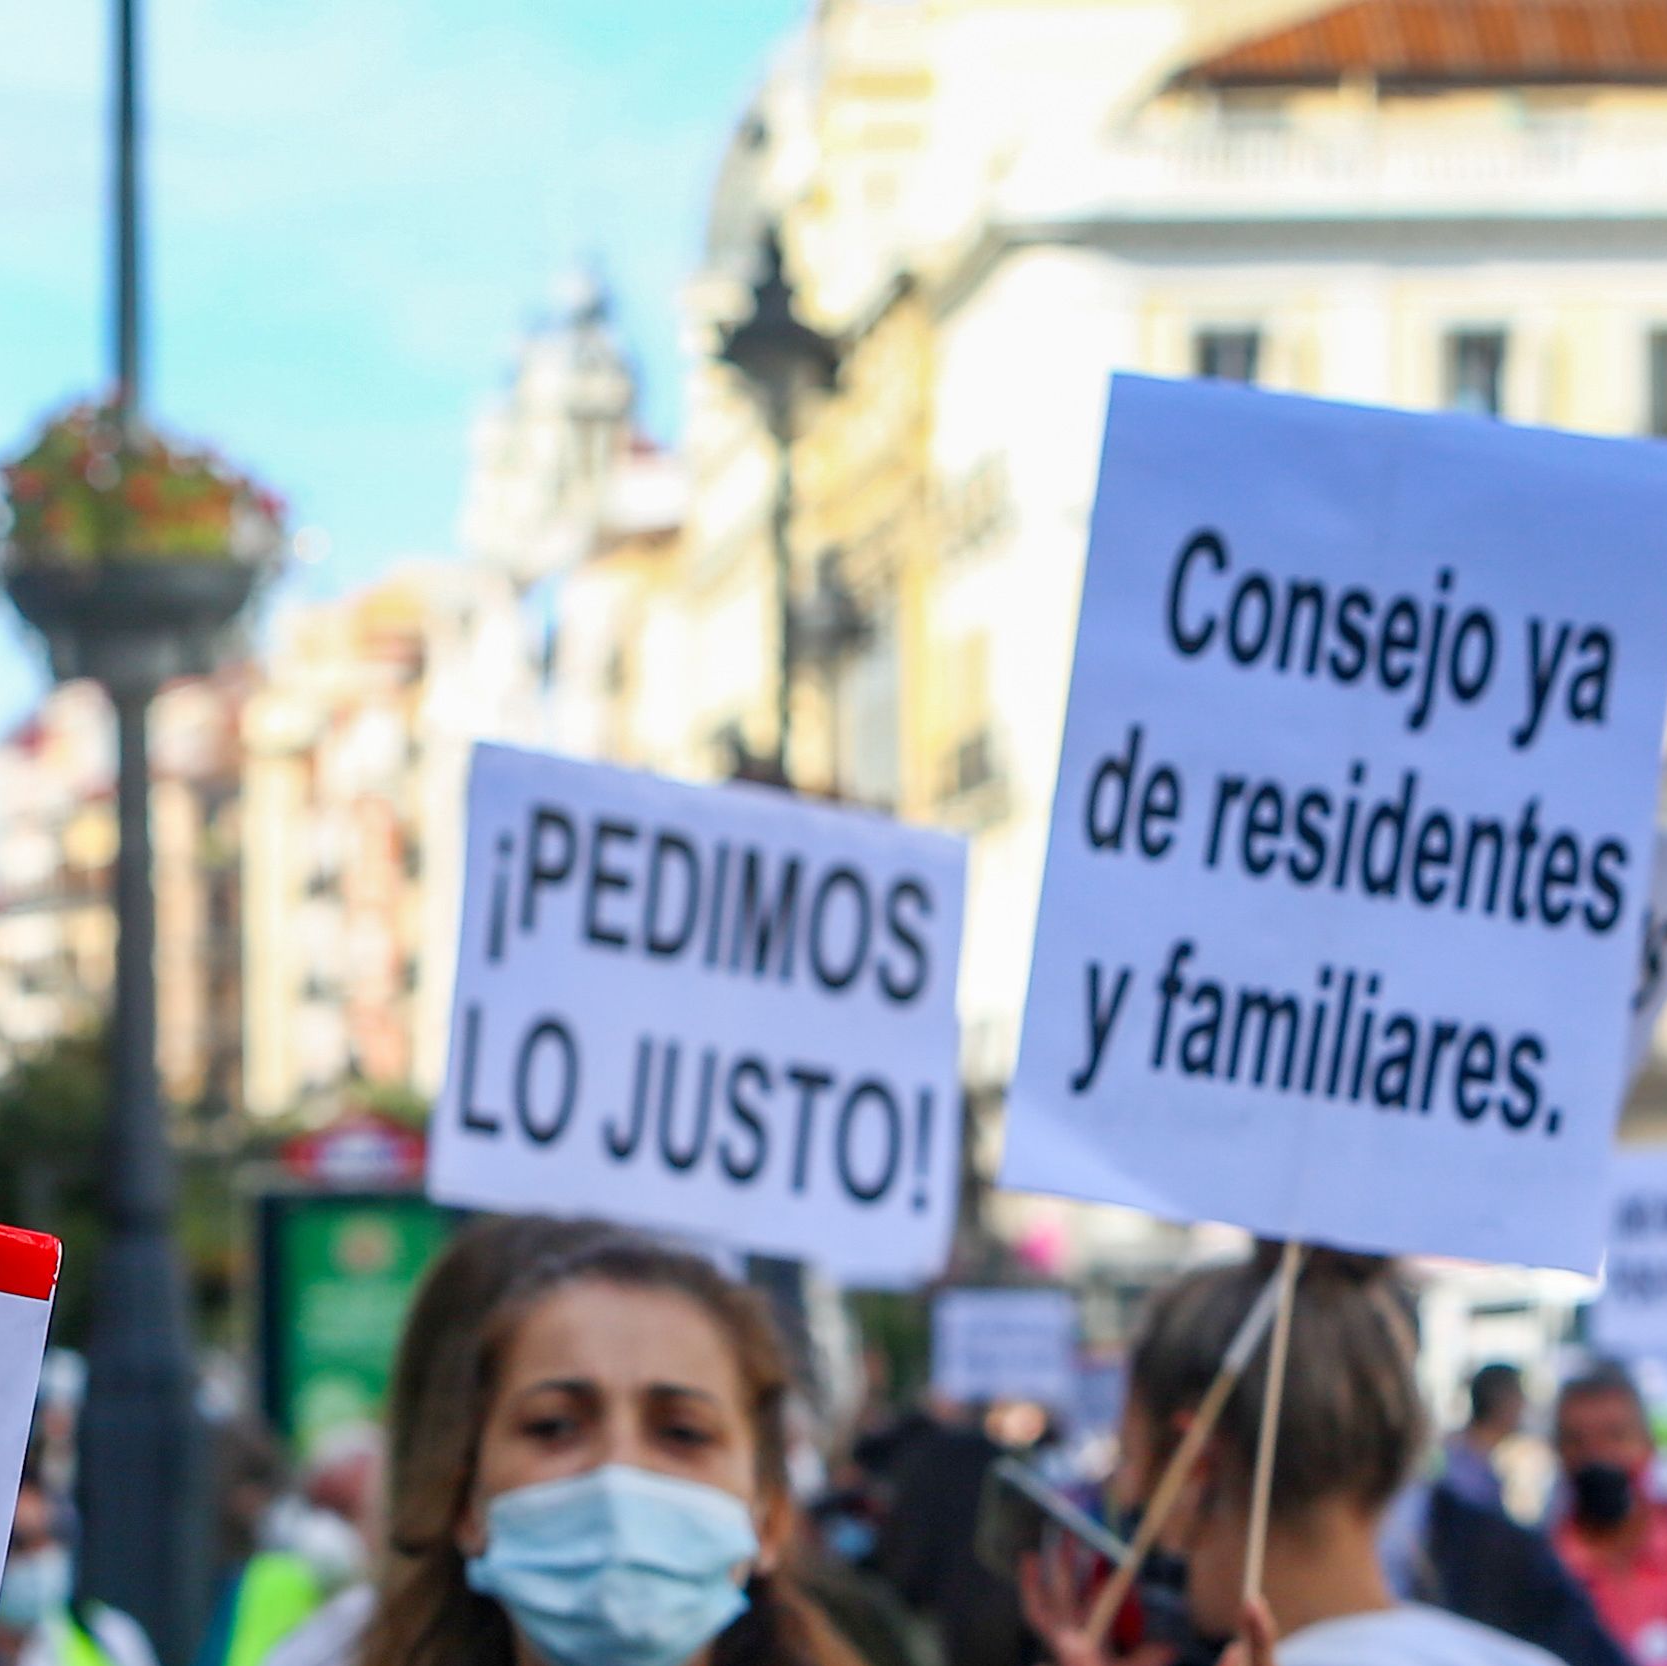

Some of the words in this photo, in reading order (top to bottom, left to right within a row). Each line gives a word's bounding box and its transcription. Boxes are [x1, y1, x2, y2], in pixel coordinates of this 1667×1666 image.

[1165, 526, 1498, 733] Consejo
[1511, 614, 1618, 752] ya
[486, 804, 934, 1008] ¡PEDIMOS
[1082, 723, 1184, 861] de
[1204, 760, 1630, 936] residentes
[456, 999, 582, 1150] LO
[600, 1034, 936, 1215] JUSTO!
[1069, 960, 1134, 1097] y
[1150, 939, 1563, 1137] familiares.
